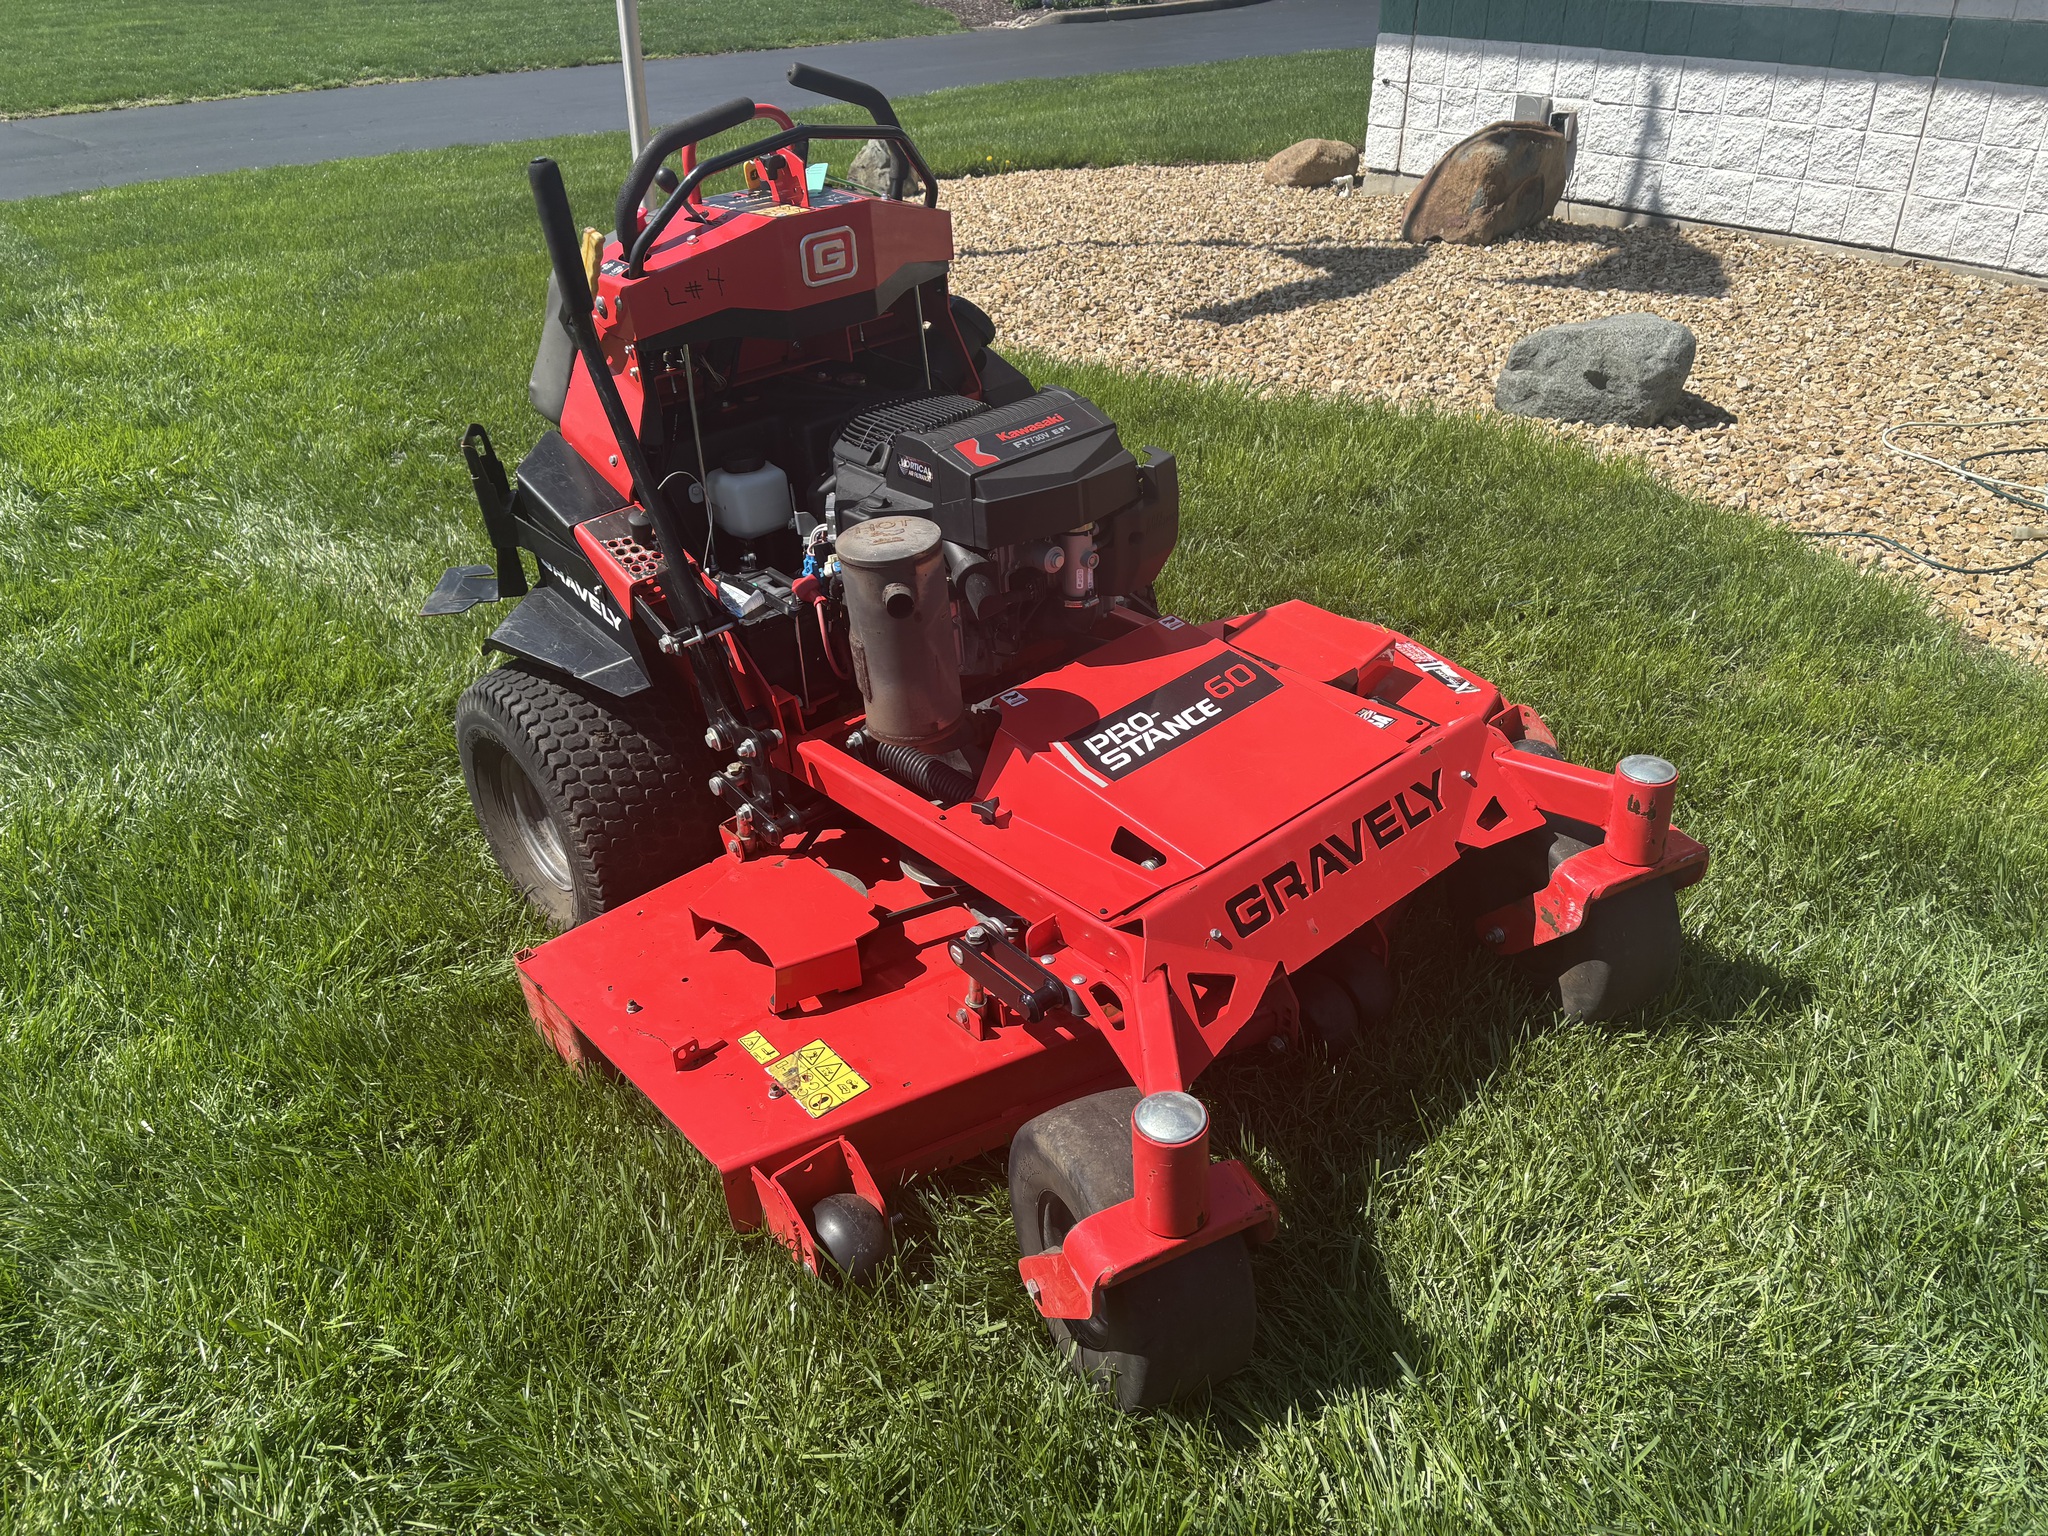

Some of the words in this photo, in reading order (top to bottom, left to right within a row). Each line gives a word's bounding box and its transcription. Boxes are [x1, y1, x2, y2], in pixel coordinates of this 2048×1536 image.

[995, 413, 1065, 442] Kawasaki
[1012, 431, 1050, 449] FT730V
[1051, 425, 1071, 436] EFI
[1203, 663, 1257, 699] 60
[1083, 711, 1161, 756] PRO-
[1100, 697, 1223, 772] STANCE
[1224, 767, 1447, 939] GRAVELY
